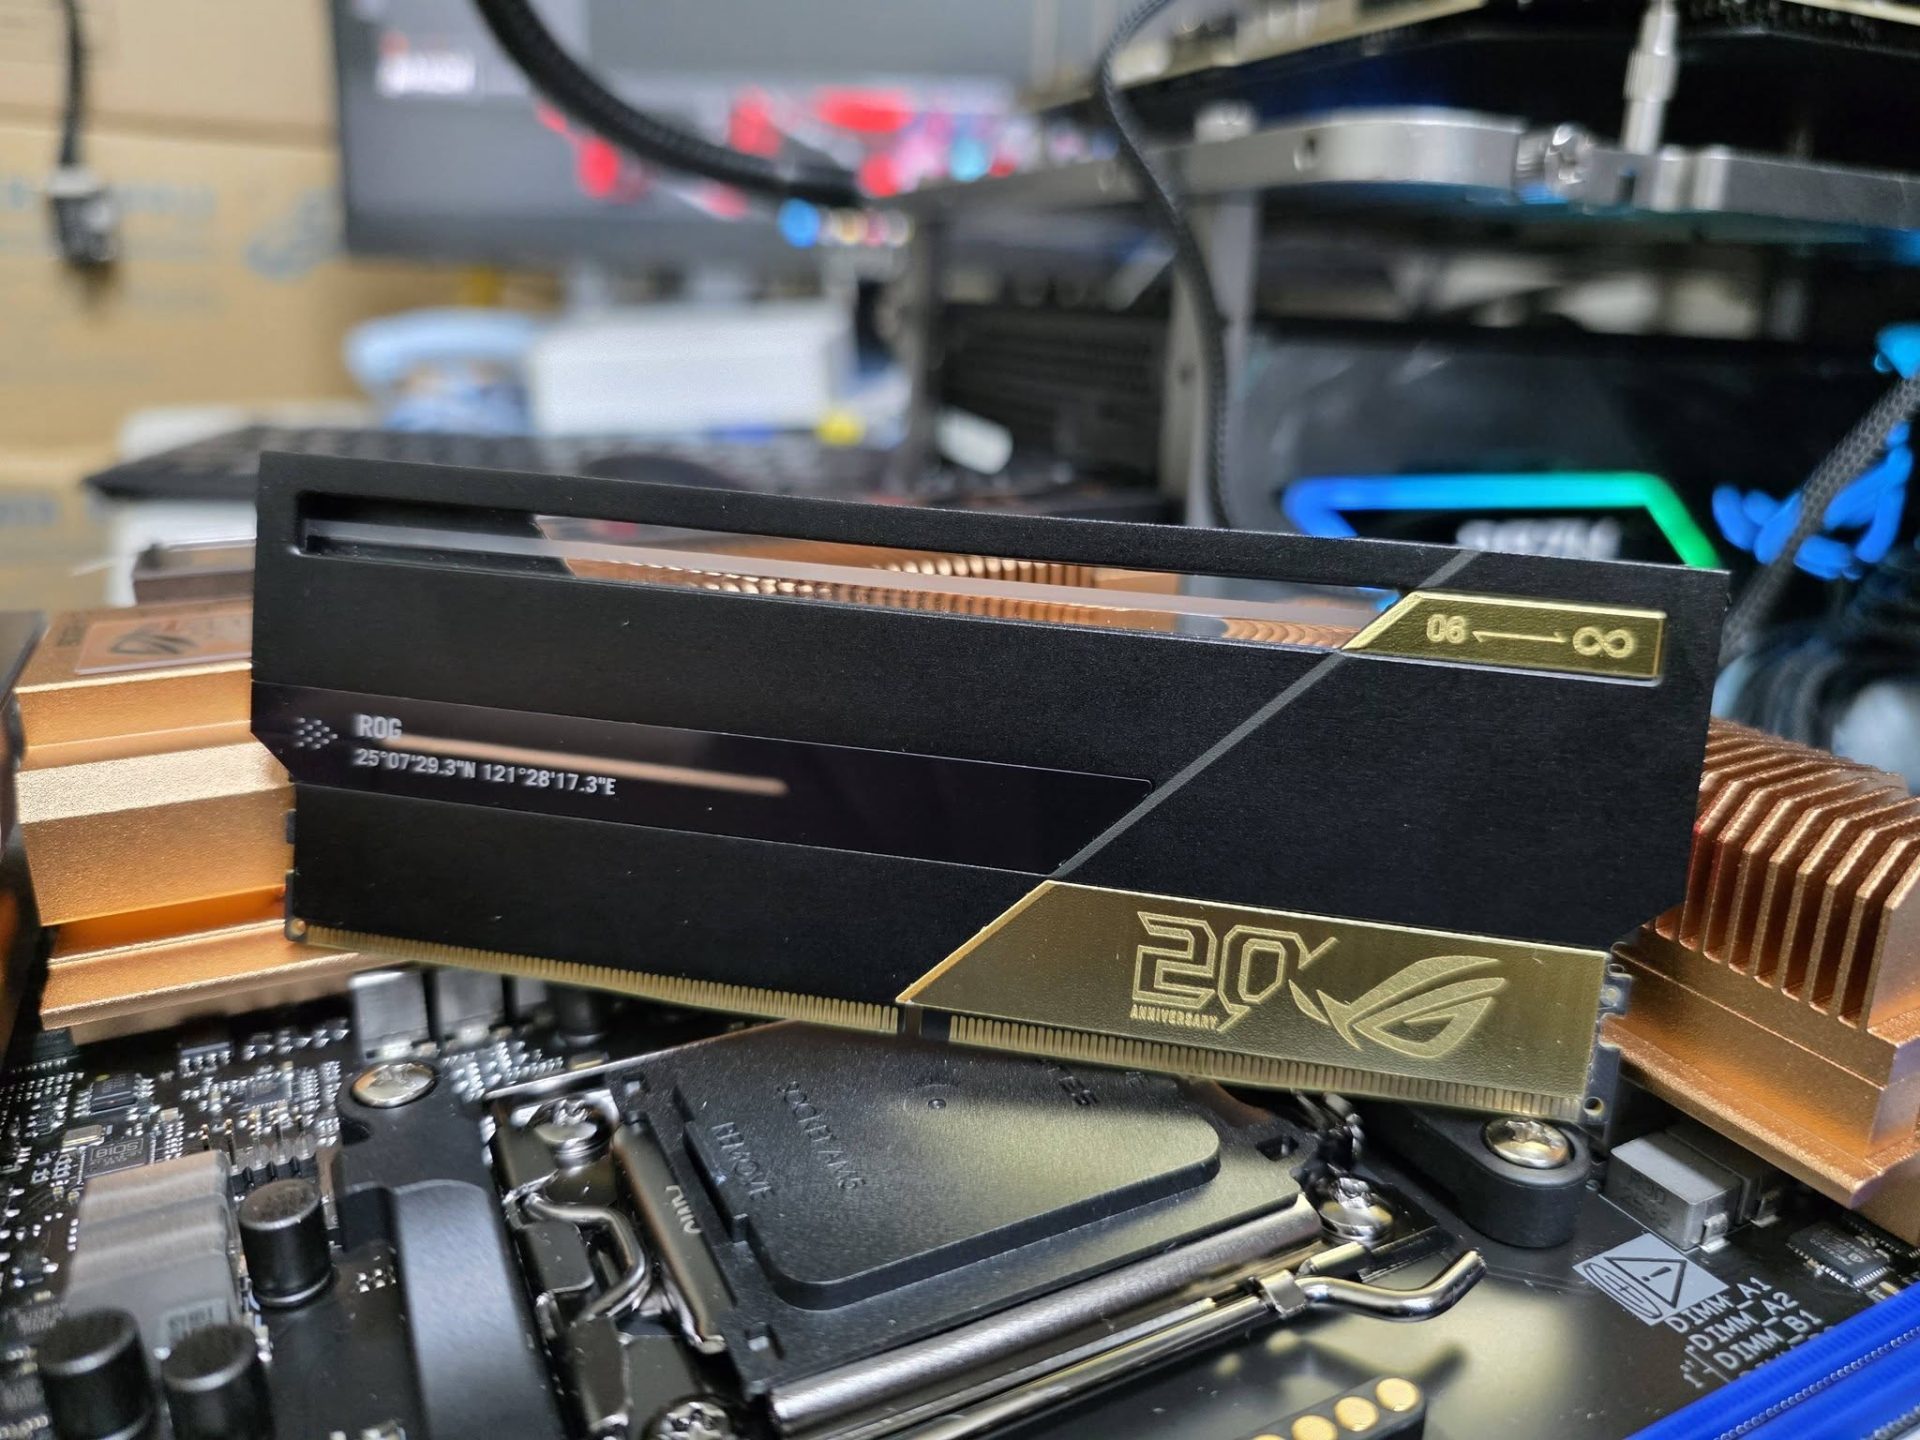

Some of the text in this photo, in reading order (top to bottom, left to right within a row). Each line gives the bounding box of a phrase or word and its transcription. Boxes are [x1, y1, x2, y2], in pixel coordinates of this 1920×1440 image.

[1426, 613, 1467, 644] 06
[355, 714, 402, 739] ROG
[1132, 911, 1310, 1018] 20
[1129, 1003, 1219, 1030] ANNIVERSARY
[1663, 1276, 1773, 1334] DIMM_A1
[1687, 1291, 1800, 1352] DIMM_A2
[1712, 1308, 1824, 1371] DIMM_B1
